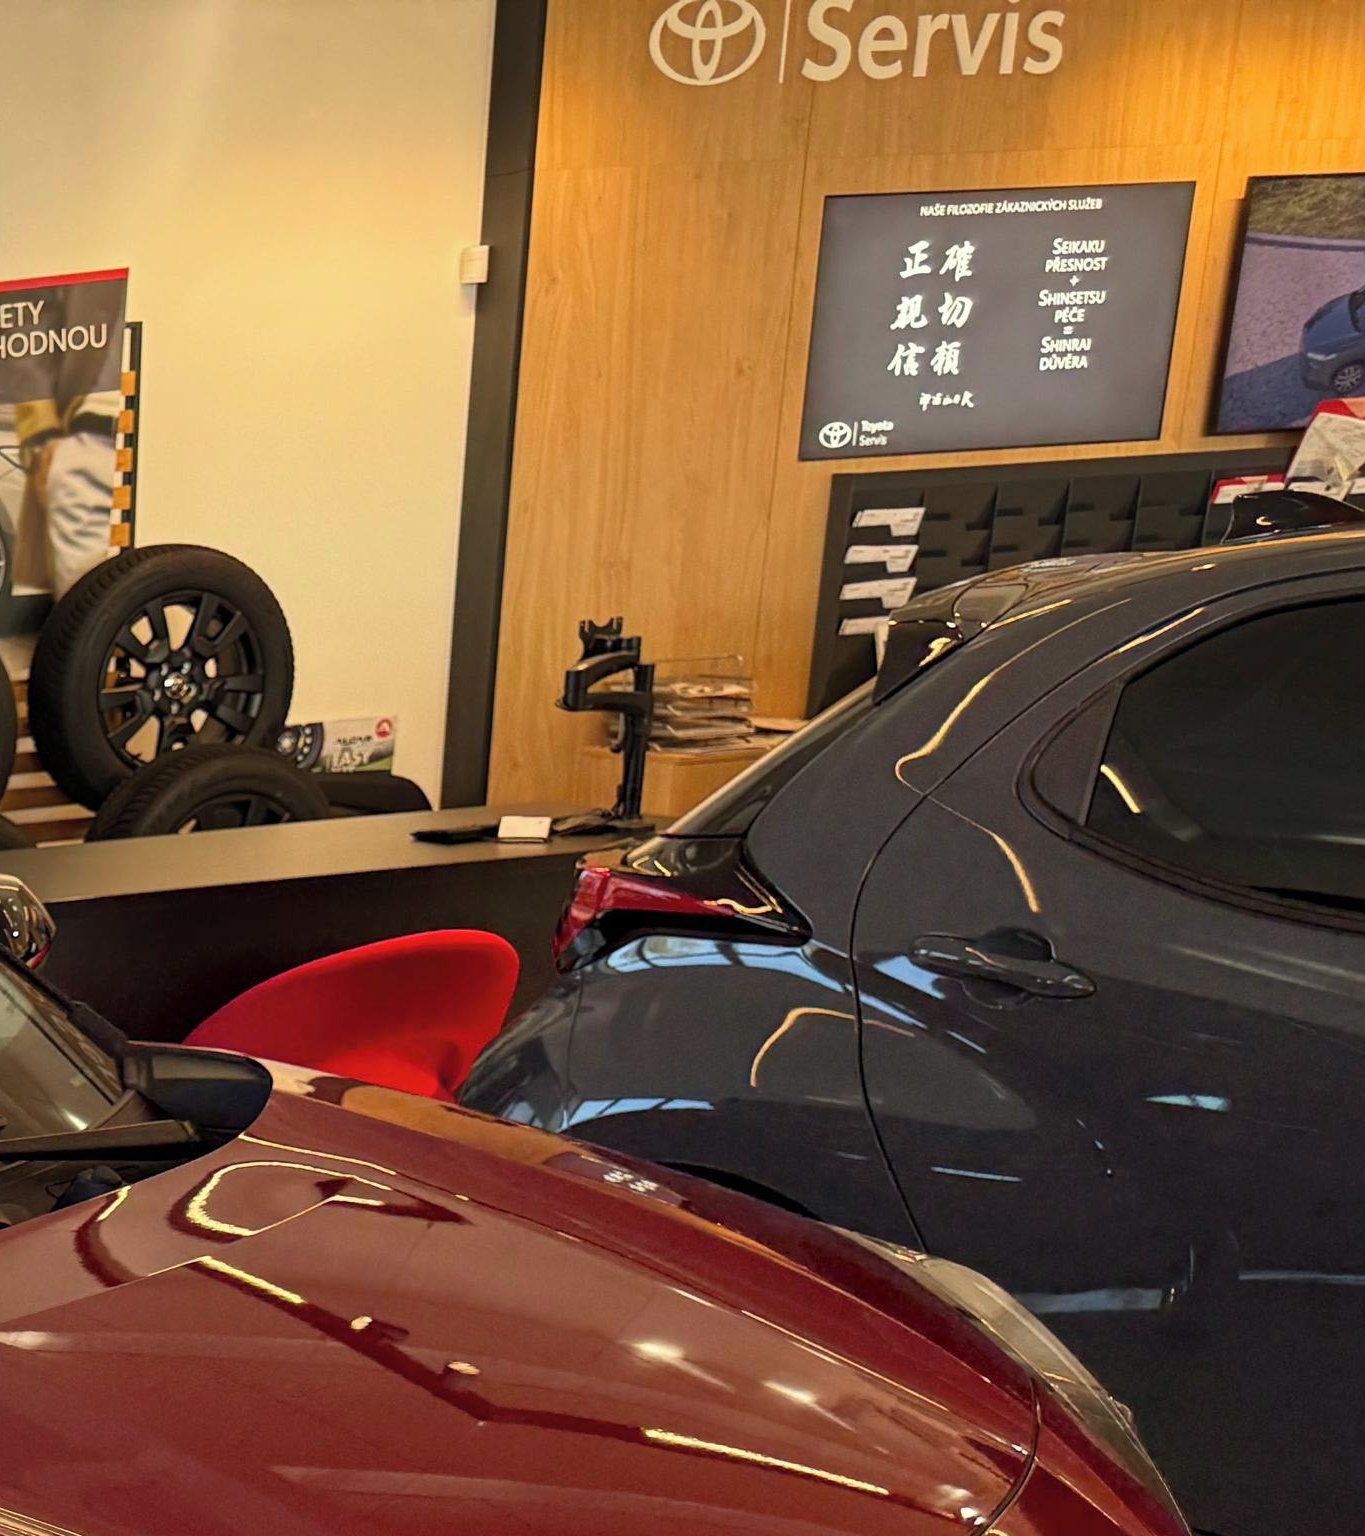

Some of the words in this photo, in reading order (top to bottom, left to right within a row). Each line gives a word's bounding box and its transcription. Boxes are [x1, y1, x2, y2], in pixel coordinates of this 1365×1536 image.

[801, 0, 1066, 82] Servis
[920, 203, 945, 216] NAŠE
[946, 201, 994, 216] FILOZOFIE
[1068, 197, 1103, 210] SLUŽEB
[1052, 237, 1106, 255] SEIKAKU
[1044, 256, 1109, 272] PŘESNOST
[1038, 289, 1107, 307] SHINSETSU
[1054, 306, 1086, 323] PÉČE
[1040, 336, 1092, 354] SHINRAI
